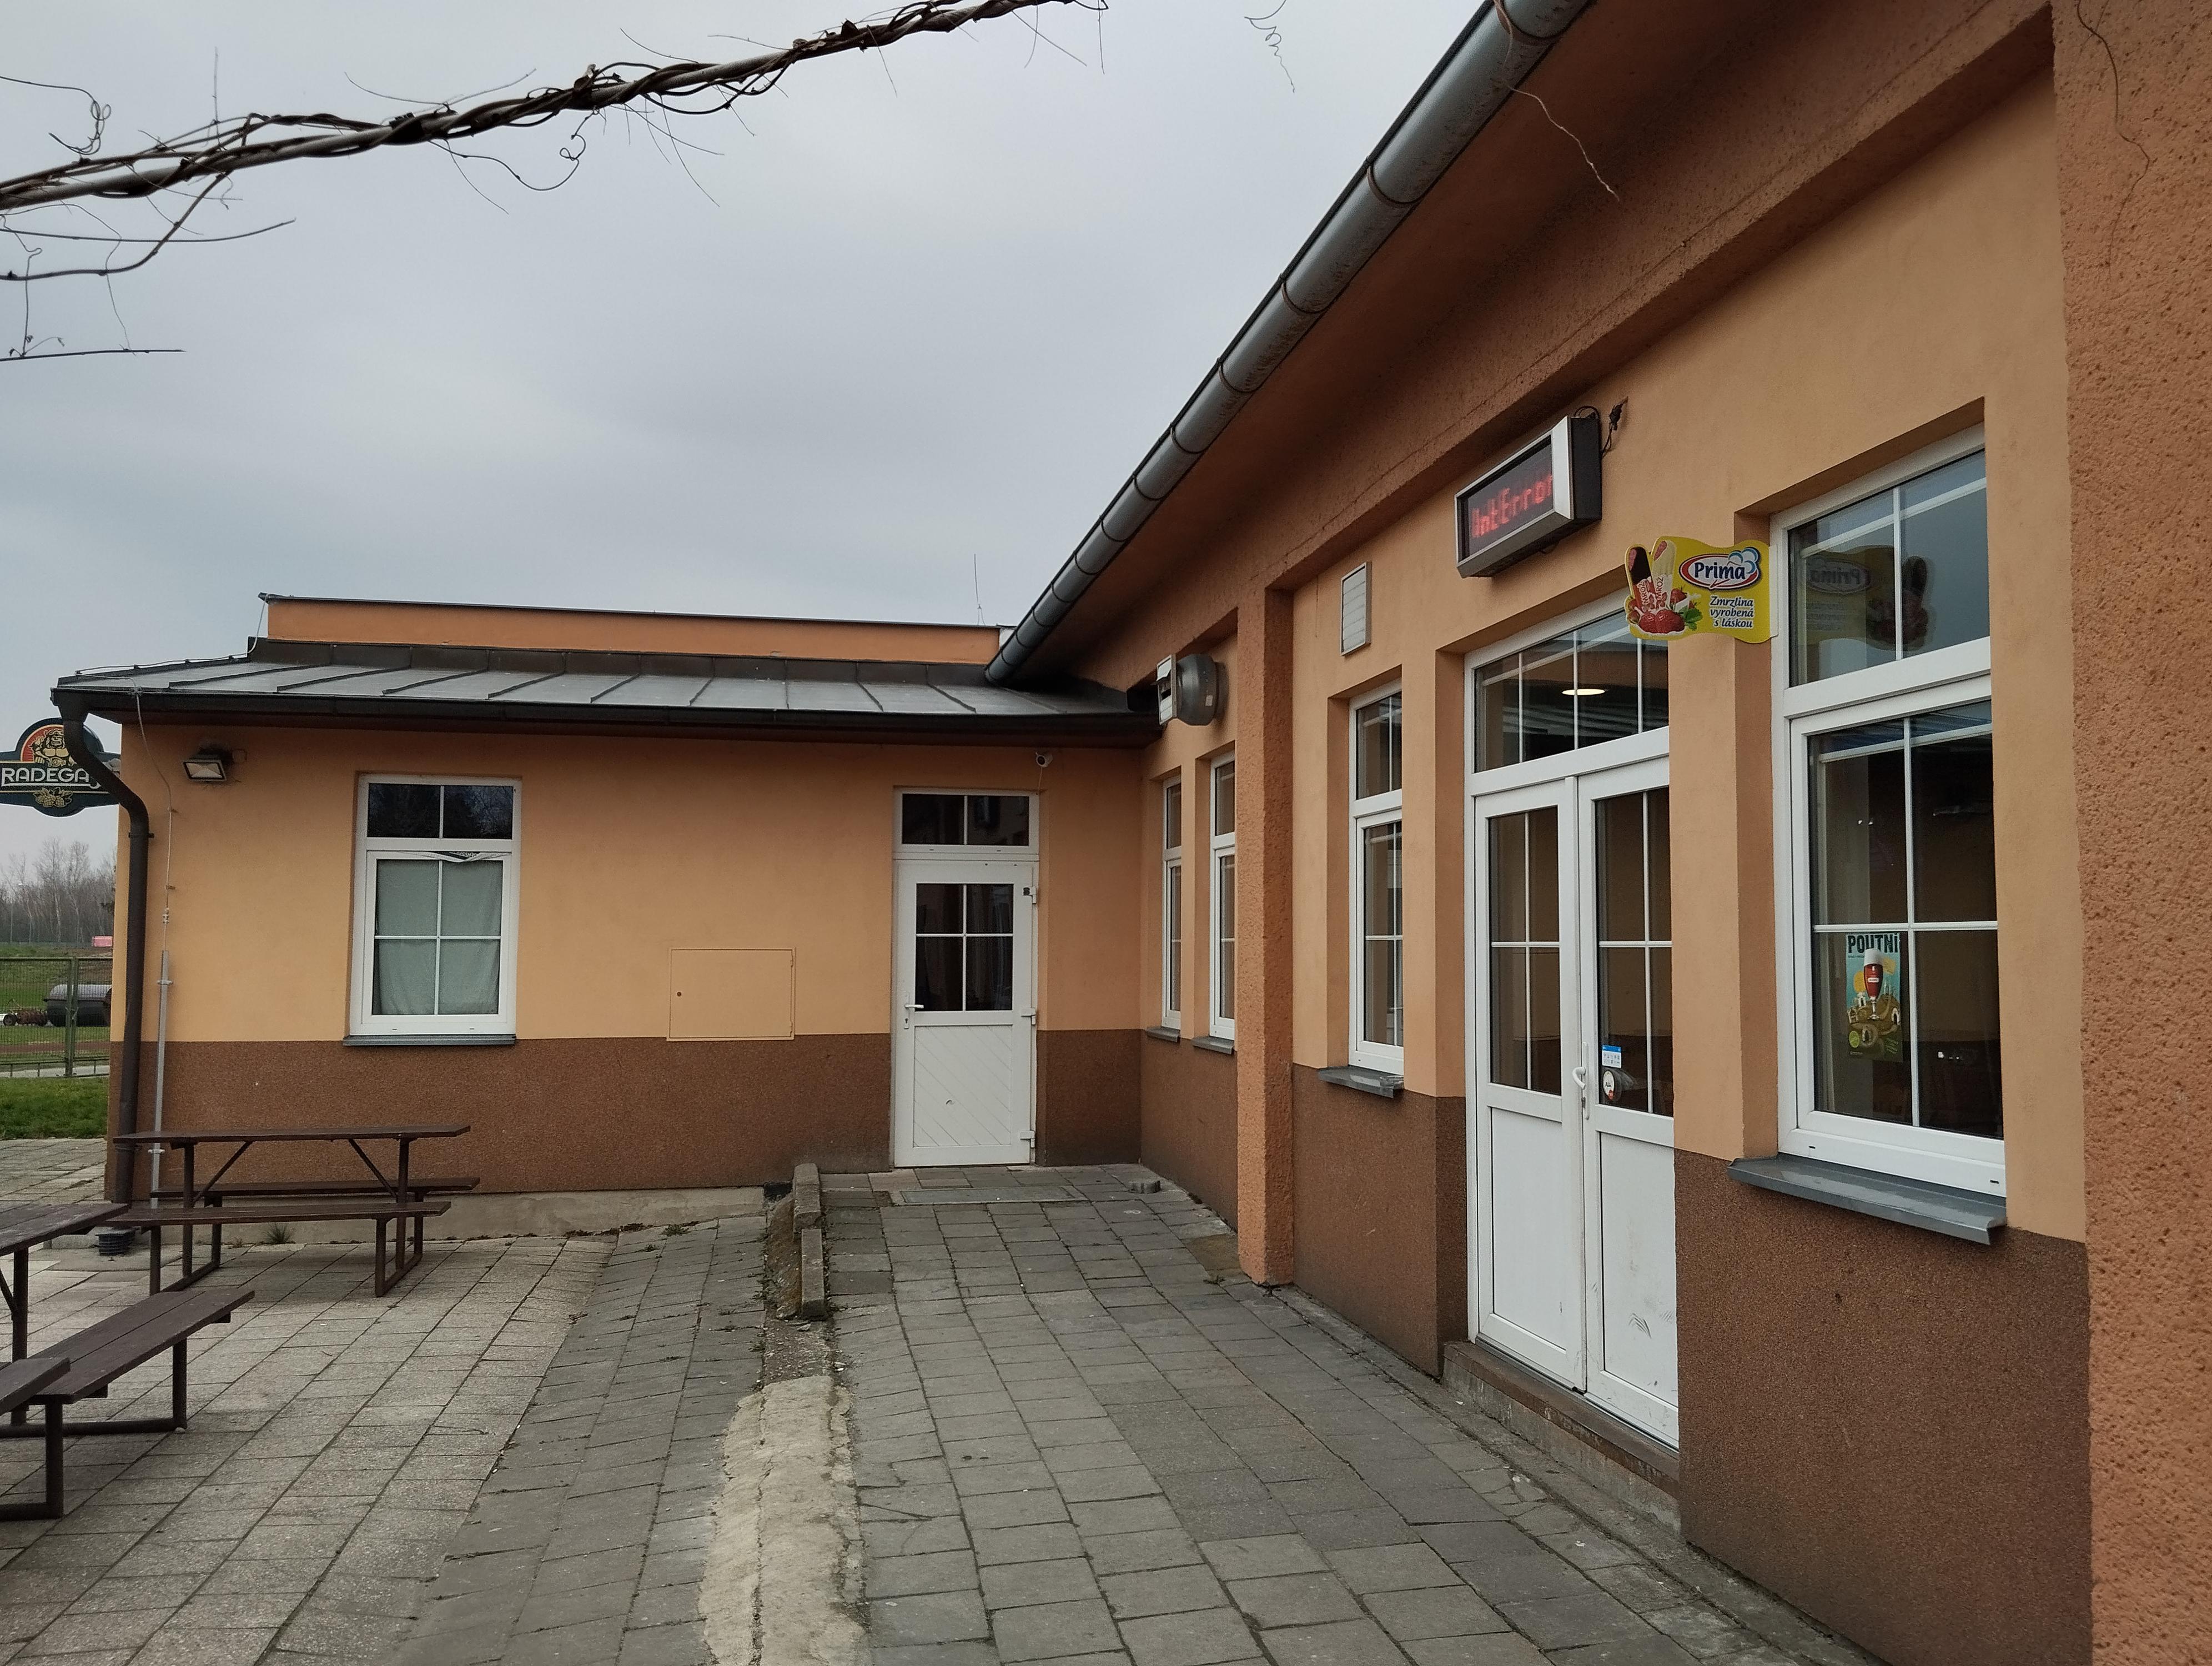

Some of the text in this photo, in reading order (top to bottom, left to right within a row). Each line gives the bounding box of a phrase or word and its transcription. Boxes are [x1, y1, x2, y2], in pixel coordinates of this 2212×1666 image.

[1694, 562, 1746, 580] Prima
[1710, 596, 1753, 608] Zmrzlina
[1711, 608, 1754, 618] vyrobená
[1722, 618, 1753, 628] láskou
[1, 767, 90, 787] RADEGA
